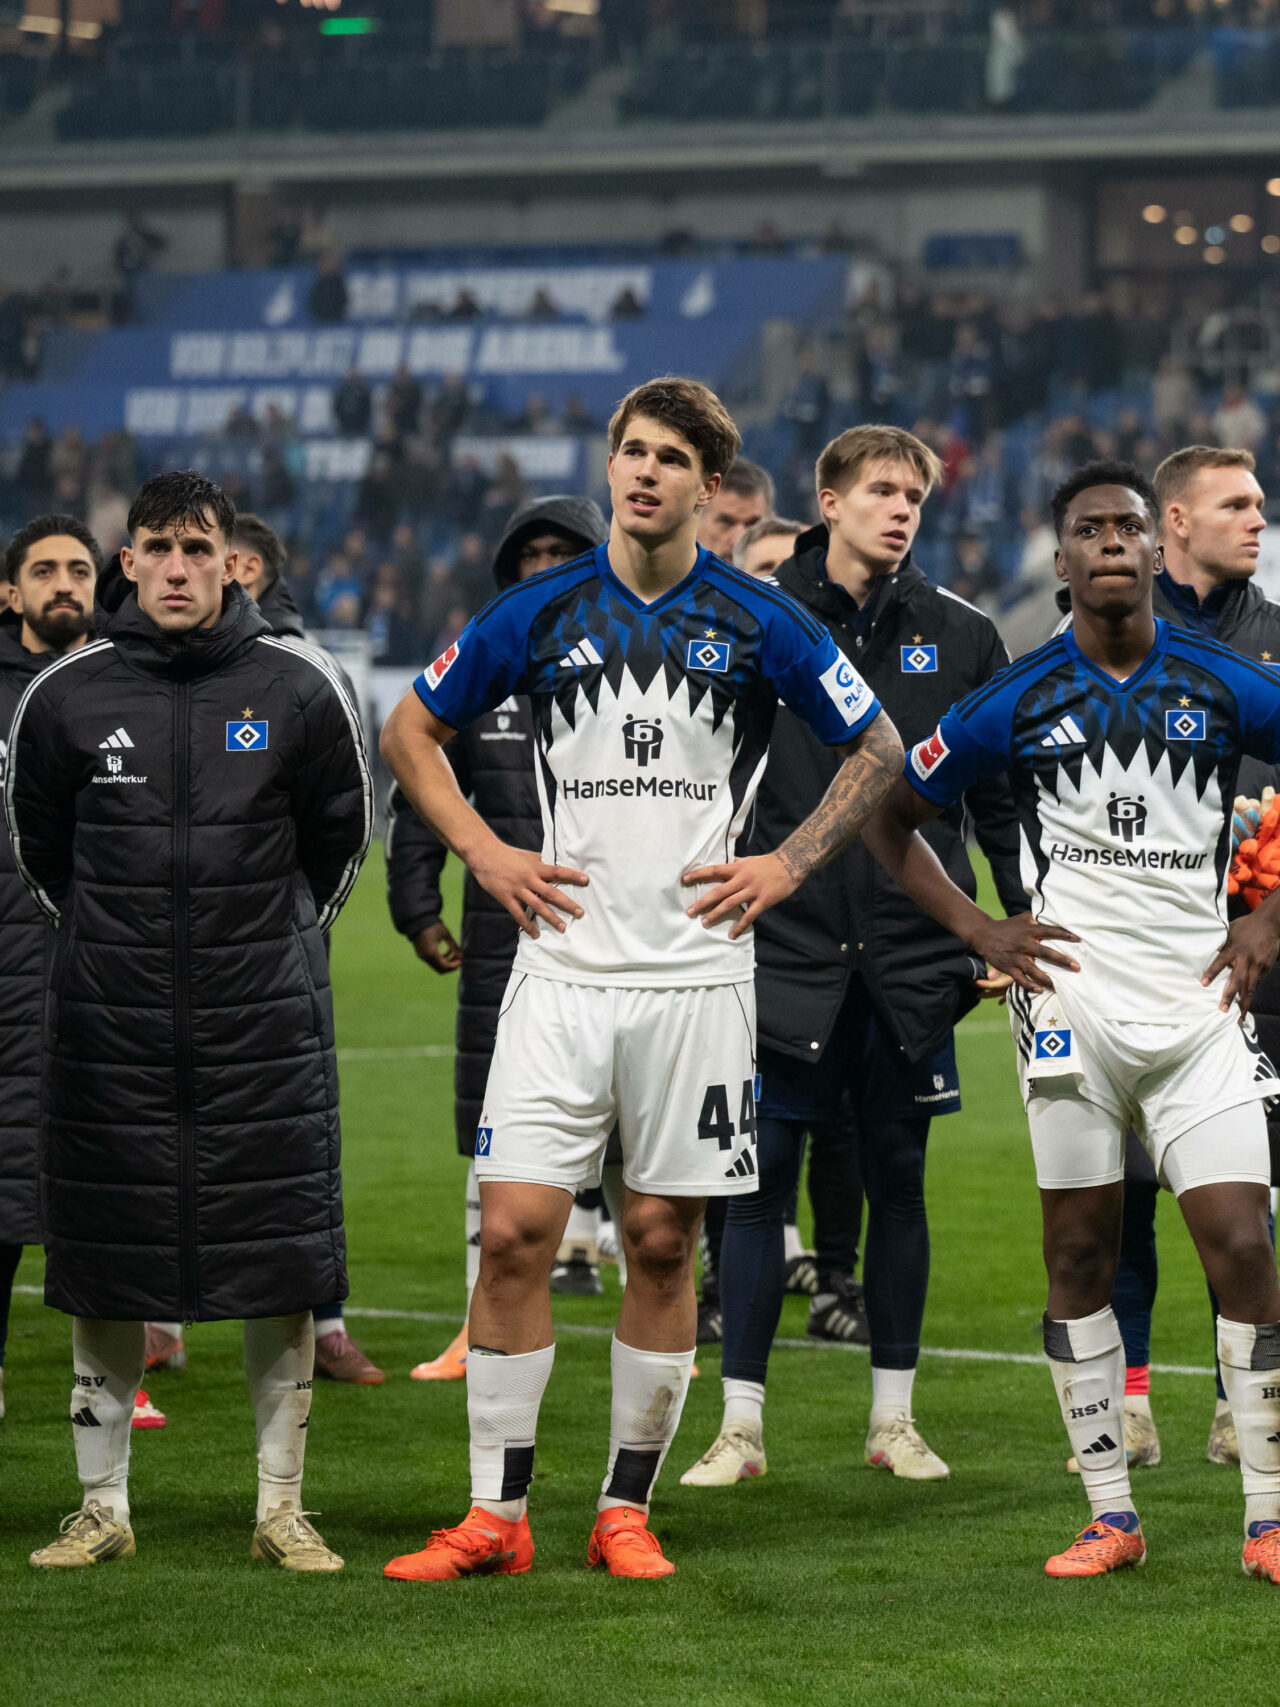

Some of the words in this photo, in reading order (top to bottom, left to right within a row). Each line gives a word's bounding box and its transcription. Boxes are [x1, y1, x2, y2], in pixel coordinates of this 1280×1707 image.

[563, 777, 717, 801] HanseMerkur
[1050, 843, 1208, 870] HanseMerkur
[698, 1079, 757, 1151] 44
[73, 1372, 107, 1388] HSV
[295, 1380, 312, 1390] HS
[1070, 1398, 1110, 1419] HSV
